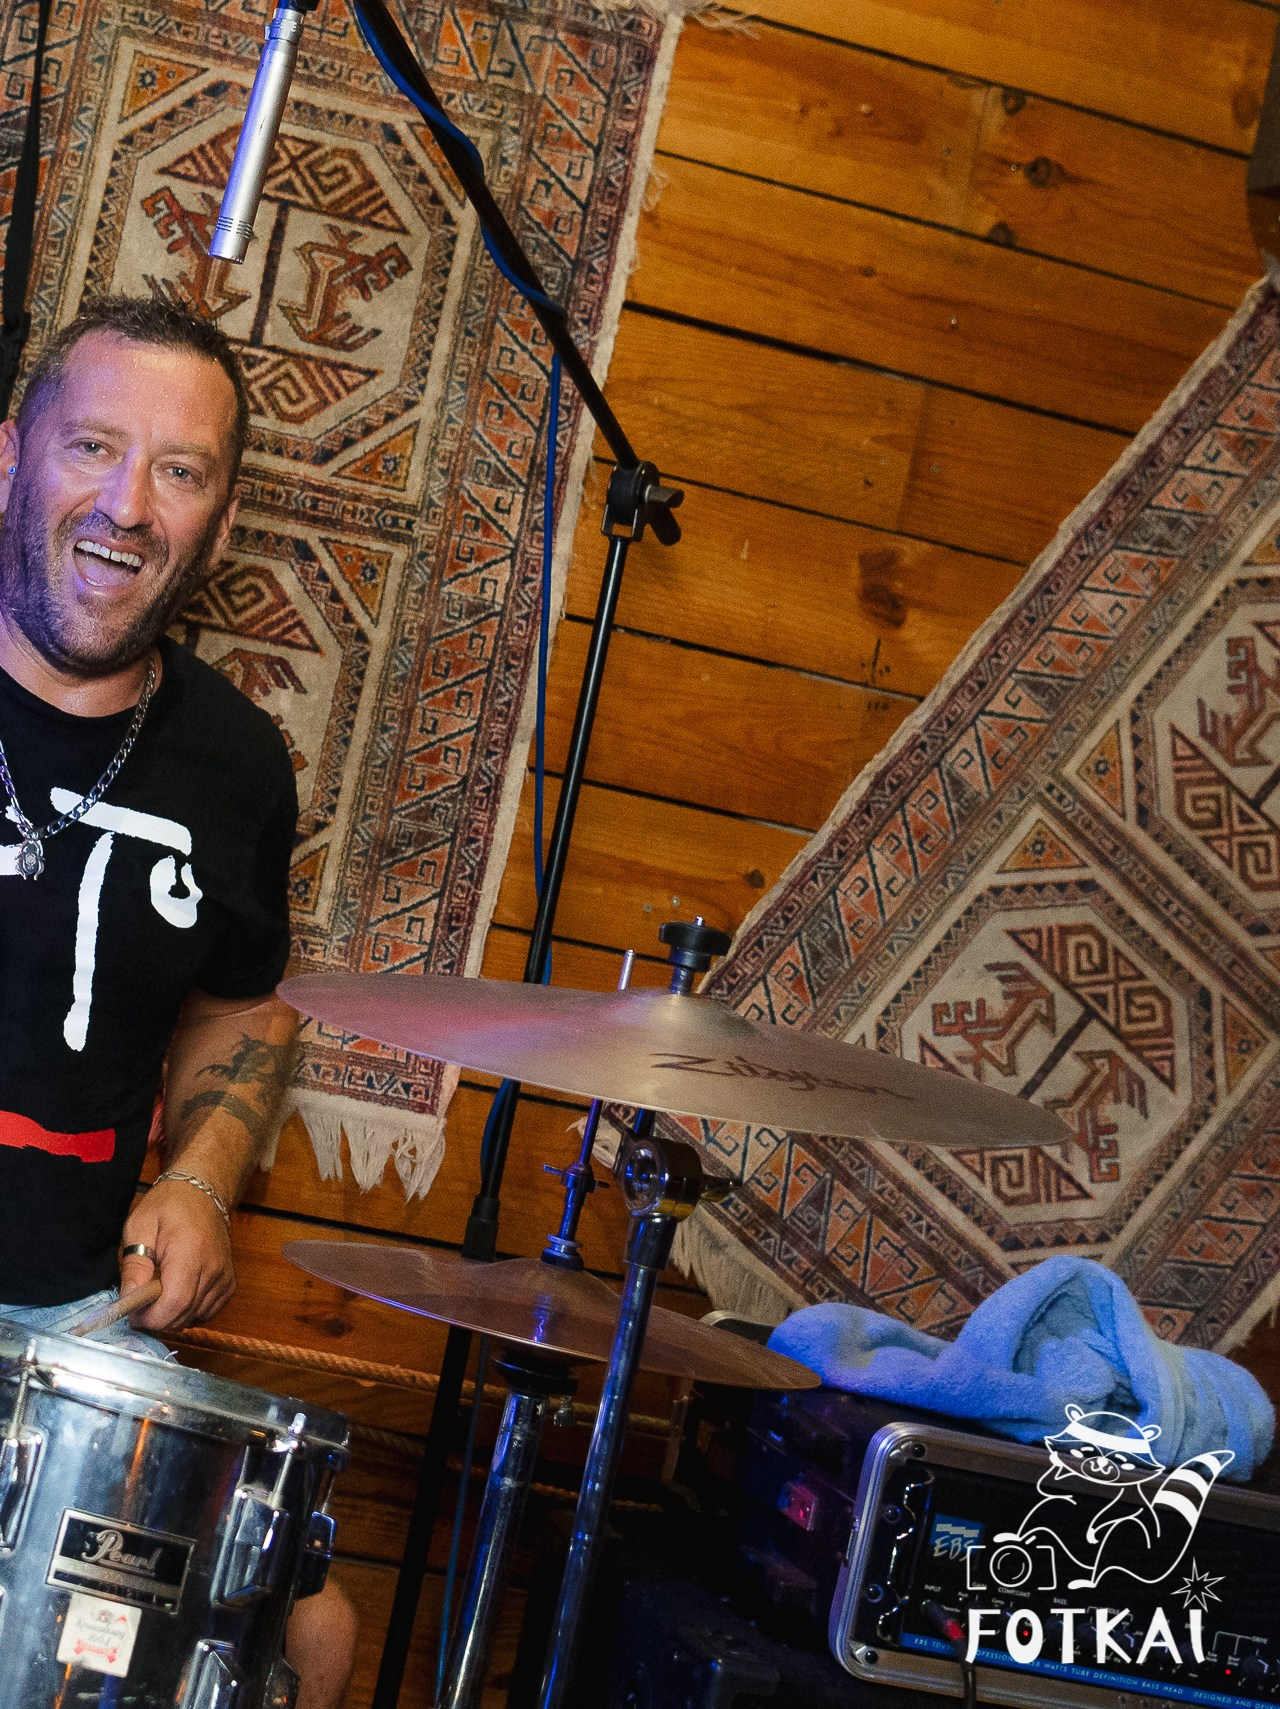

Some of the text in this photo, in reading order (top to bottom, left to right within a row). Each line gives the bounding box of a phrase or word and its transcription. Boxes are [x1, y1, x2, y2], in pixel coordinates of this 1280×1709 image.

[81, 1529, 163, 1572] Pearl
[933, 1535, 974, 1562] EBS
[914, 1637, 928, 1646] EBS
[1044, 1663, 1068, 1673] WATTS
[1071, 1667, 1090, 1677] TUBE
[1093, 1671, 1138, 1685] DEFINITION
[1141, 1681, 1160, 1690] BASS
[1163, 1685, 1184, 1695] HEAD
[1193, 1691, 1231, 1704] DESIGNED
[1235, 1699, 1251, 1707] AND
